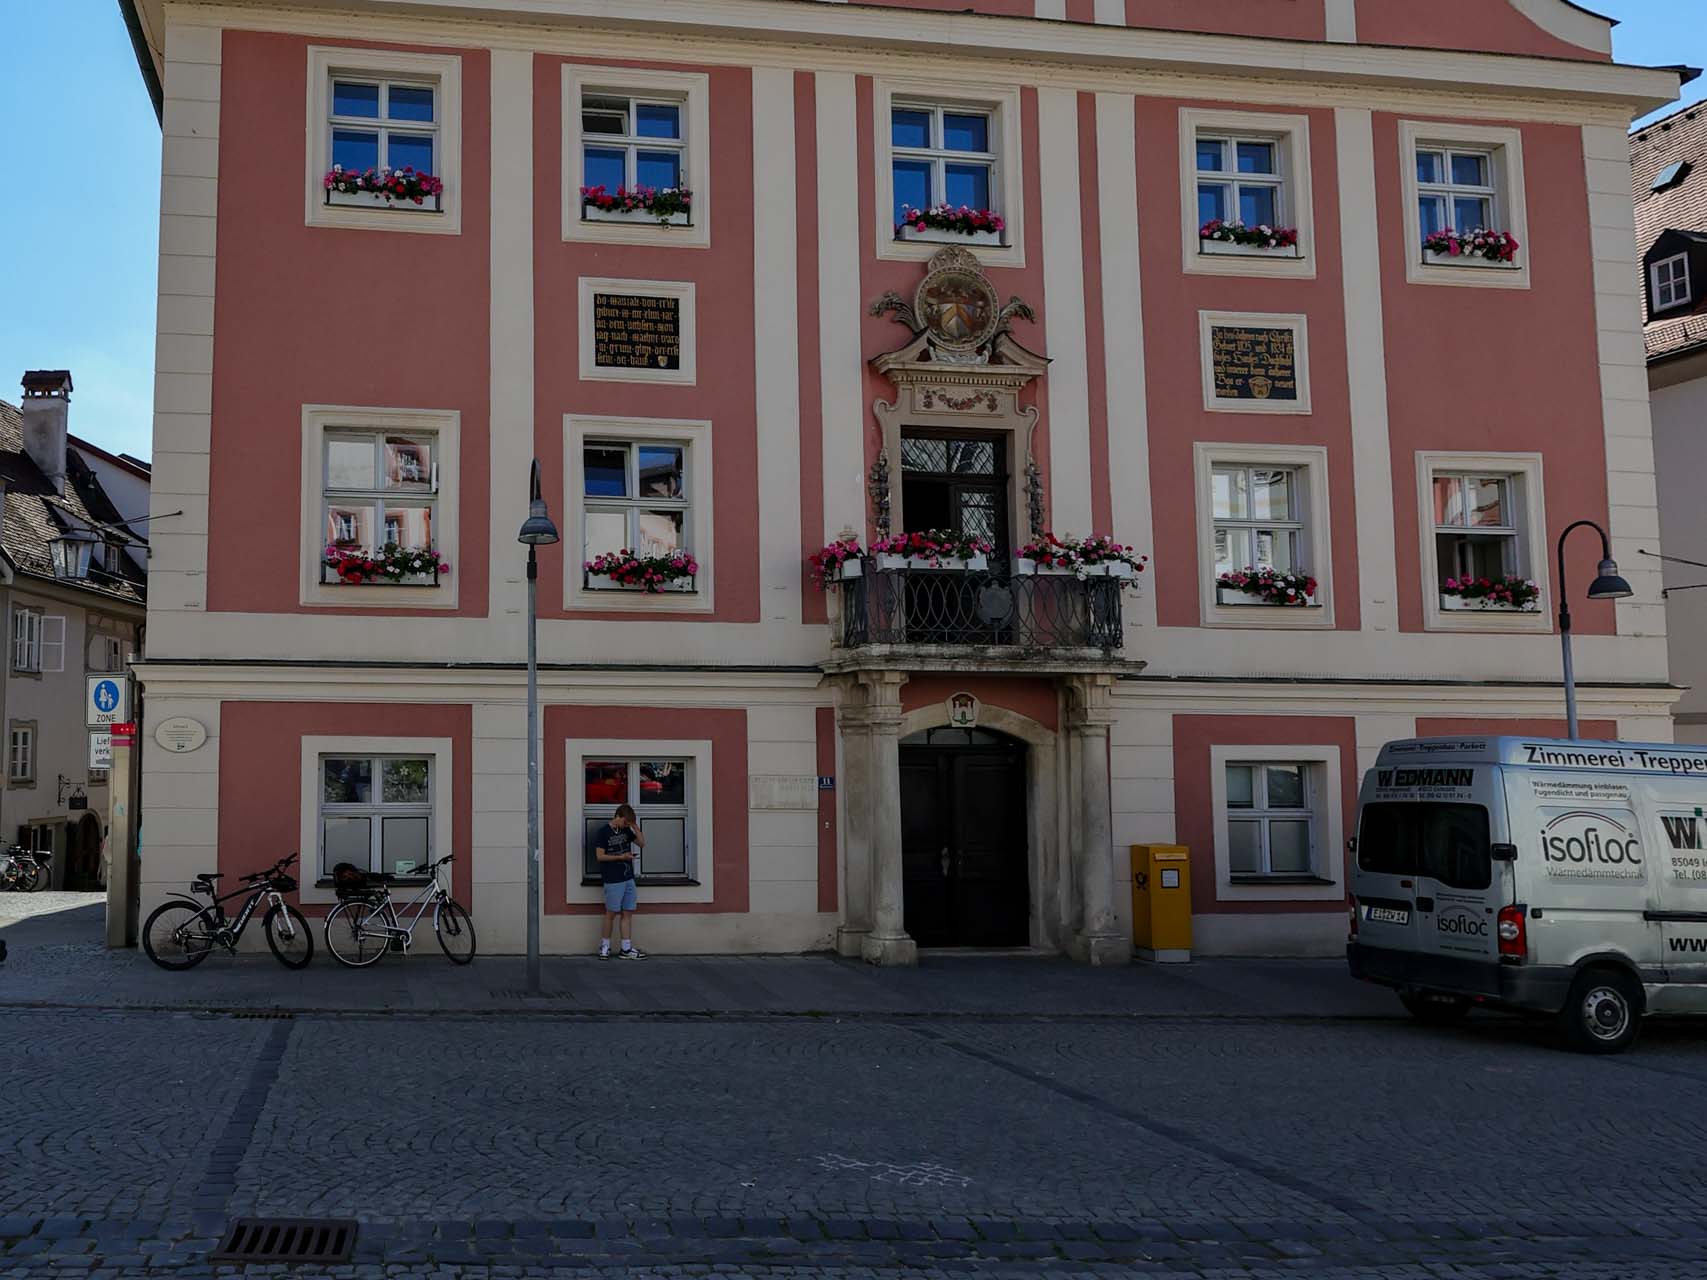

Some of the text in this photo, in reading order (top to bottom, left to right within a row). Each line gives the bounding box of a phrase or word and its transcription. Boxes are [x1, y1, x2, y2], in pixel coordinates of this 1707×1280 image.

[96, 714, 116, 723] ZONE
[1524, 746, 1707, 774] Zimmerei Treppe
[1540, 827, 1642, 864] isofloc
[1671, 857, 1700, 867] 85049
[1545, 865, 1645, 880] Wärmedämmtechnik
[1672, 869, 1690, 880] Tel.
[1437, 914, 1489, 937] isofloc
